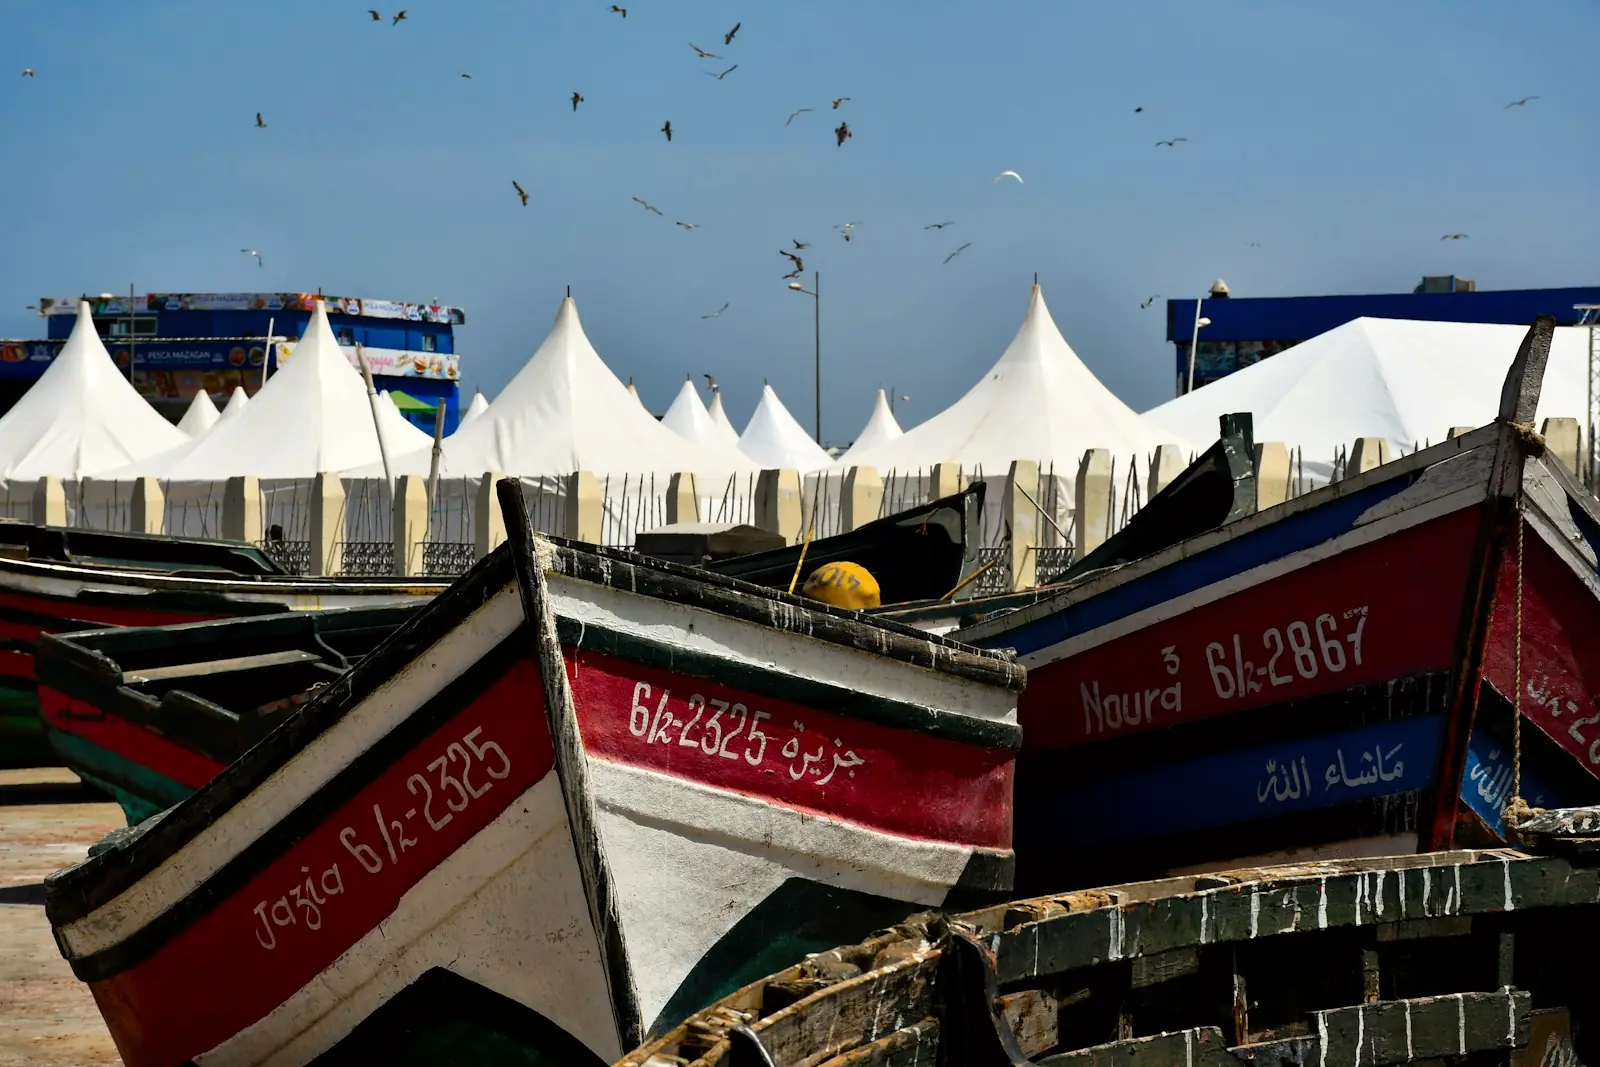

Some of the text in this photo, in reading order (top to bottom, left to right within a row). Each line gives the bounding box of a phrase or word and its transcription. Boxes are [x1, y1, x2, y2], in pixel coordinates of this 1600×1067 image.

[147, 350, 211, 360] PESCA MAZAGAN
[1080, 679, 1182, 736] Noura
[1205, 605, 1369, 700] 6/2-2867
[629, 681, 772, 766] 6/2-2325
[781, 719, 865, 786] جزيرة
[339, 725, 511, 874] 6/2-2325
